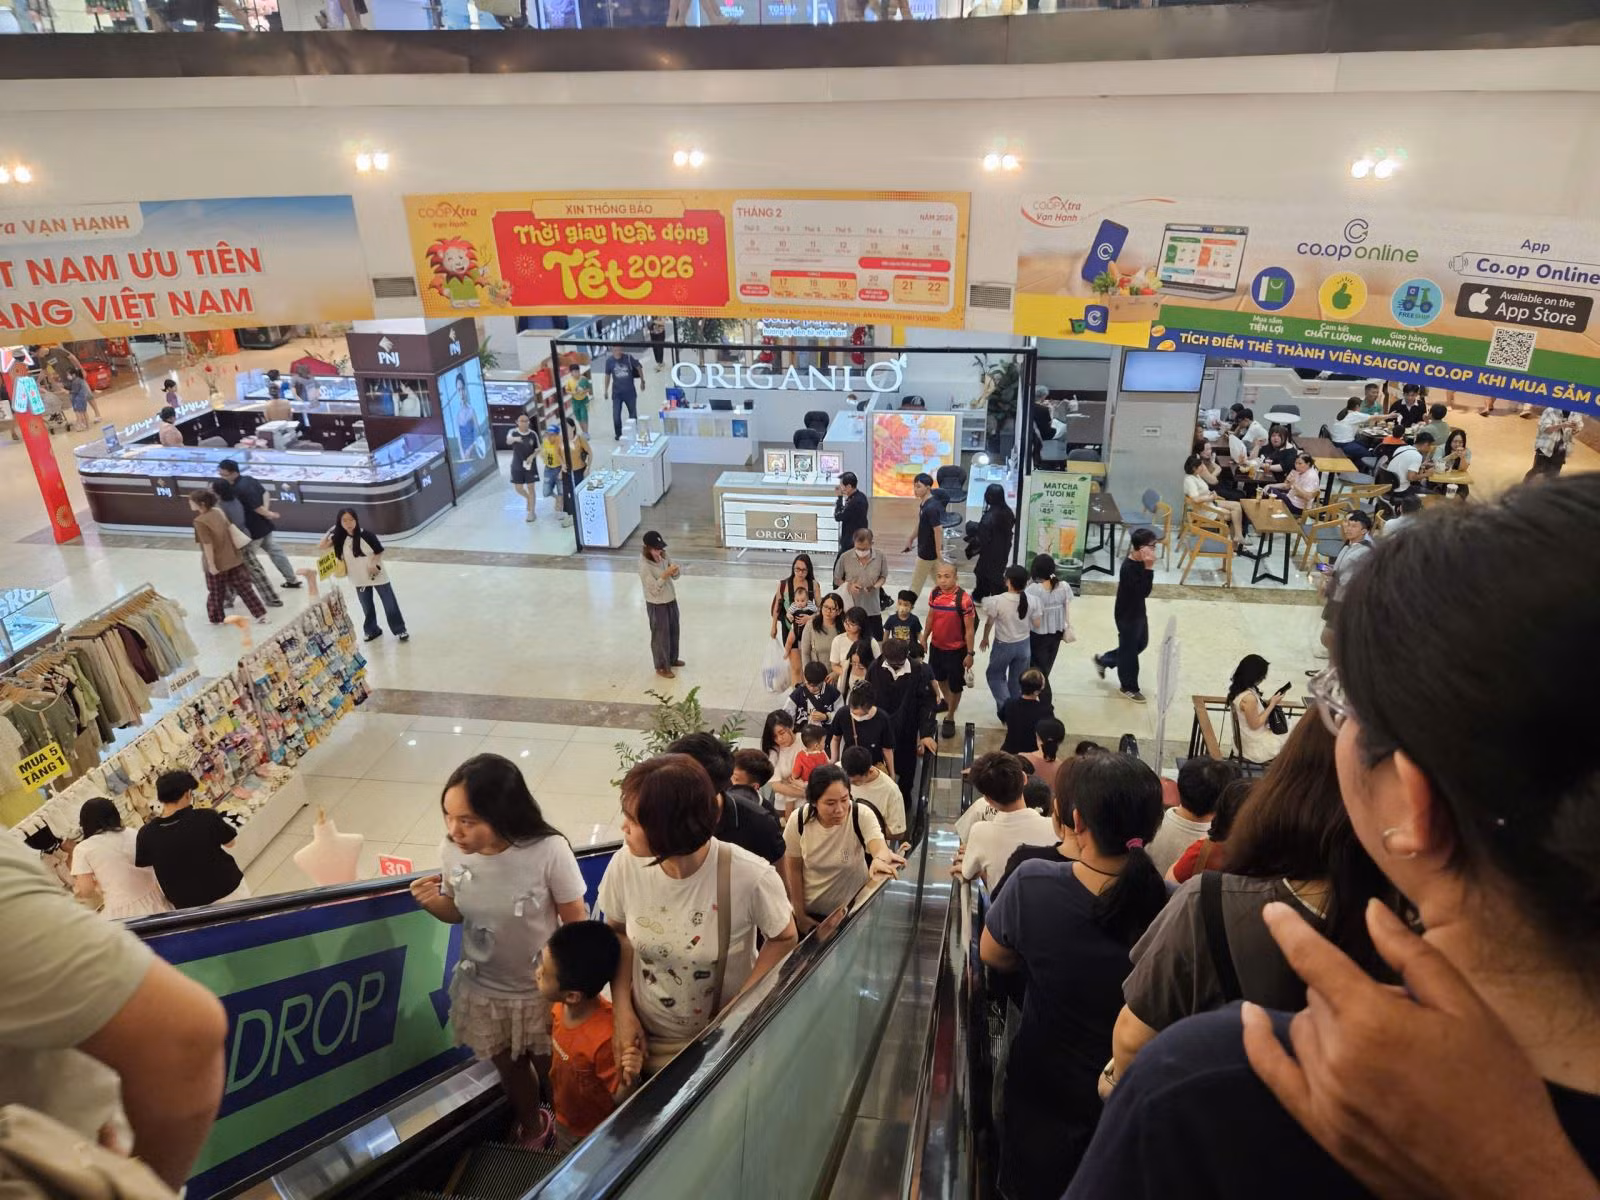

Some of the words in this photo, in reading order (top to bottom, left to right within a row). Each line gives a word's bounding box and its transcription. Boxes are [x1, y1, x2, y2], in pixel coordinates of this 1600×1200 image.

[566, 205, 584, 214] XIN
[586, 203, 628, 215] THÔNG
[629, 203, 653, 215] BÁO
[736, 205, 774, 218] THÁNG
[775, 208, 783, 218] 2
[22, 218, 67, 237] VẠN
[72, 215, 130, 235] HẠNH
[513, 221, 560, 246] Thời
[565, 222, 607, 244] gian
[661, 222, 709, 245] động
[1520, 239, 1551, 254] App
[25, 254, 120, 286] NAM
[127, 247, 178, 279] ƯU
[186, 240, 263, 276] TIÊN
[1476, 258, 1530, 279] Co.op
[1536, 264, 1600, 285] Online
[542, 248, 653, 300] Tết
[627, 254, 695, 279] 2026
[902, 281, 913, 290] 21
[927, 283, 941, 292] 22
[81, 286, 156, 327] VIỆT
[167, 287, 254, 316] NAM
[1500, 291, 1543, 304] Available
[1544, 296, 1558, 306] on
[1558, 297, 1576, 309] the
[1494, 302, 1530, 322] App
[1532, 306, 1577, 326] Store
[1304, 328, 1331, 340] CHẤT
[1319, 322, 1337, 332] Cam
[1371, 336, 1407, 349] NHANH
[1389, 331, 1407, 340] Giao
[1408, 334, 1428, 344] hàng
[377, 351, 400, 368] PNJ
[1179, 331, 1209, 345] TÍCH
[1211, 334, 1244, 350] ĐIỂM
[1247, 338, 1274, 353] THẺ
[1276, 341, 1325, 360] THÀNH
[1329, 349, 1362, 365] VIÊN
[1363, 355, 1421, 373] SAIGON
[1423, 364, 1473, 382] CO.OP
[1477, 372, 1507, 388] KHI
[1509, 377, 1548, 396] MUA
[1551, 383, 1591, 404] SẮM
[671, 361, 853, 392] ORIGANI
[1043, 482, 1079, 491] MATCHA
[755, 529, 808, 541] ORIGANI
[18, 753, 48, 774] MUA
[49, 746, 58, 756] 5
[56, 755, 65, 766] 1
[225, 970, 386, 1094] DROP
